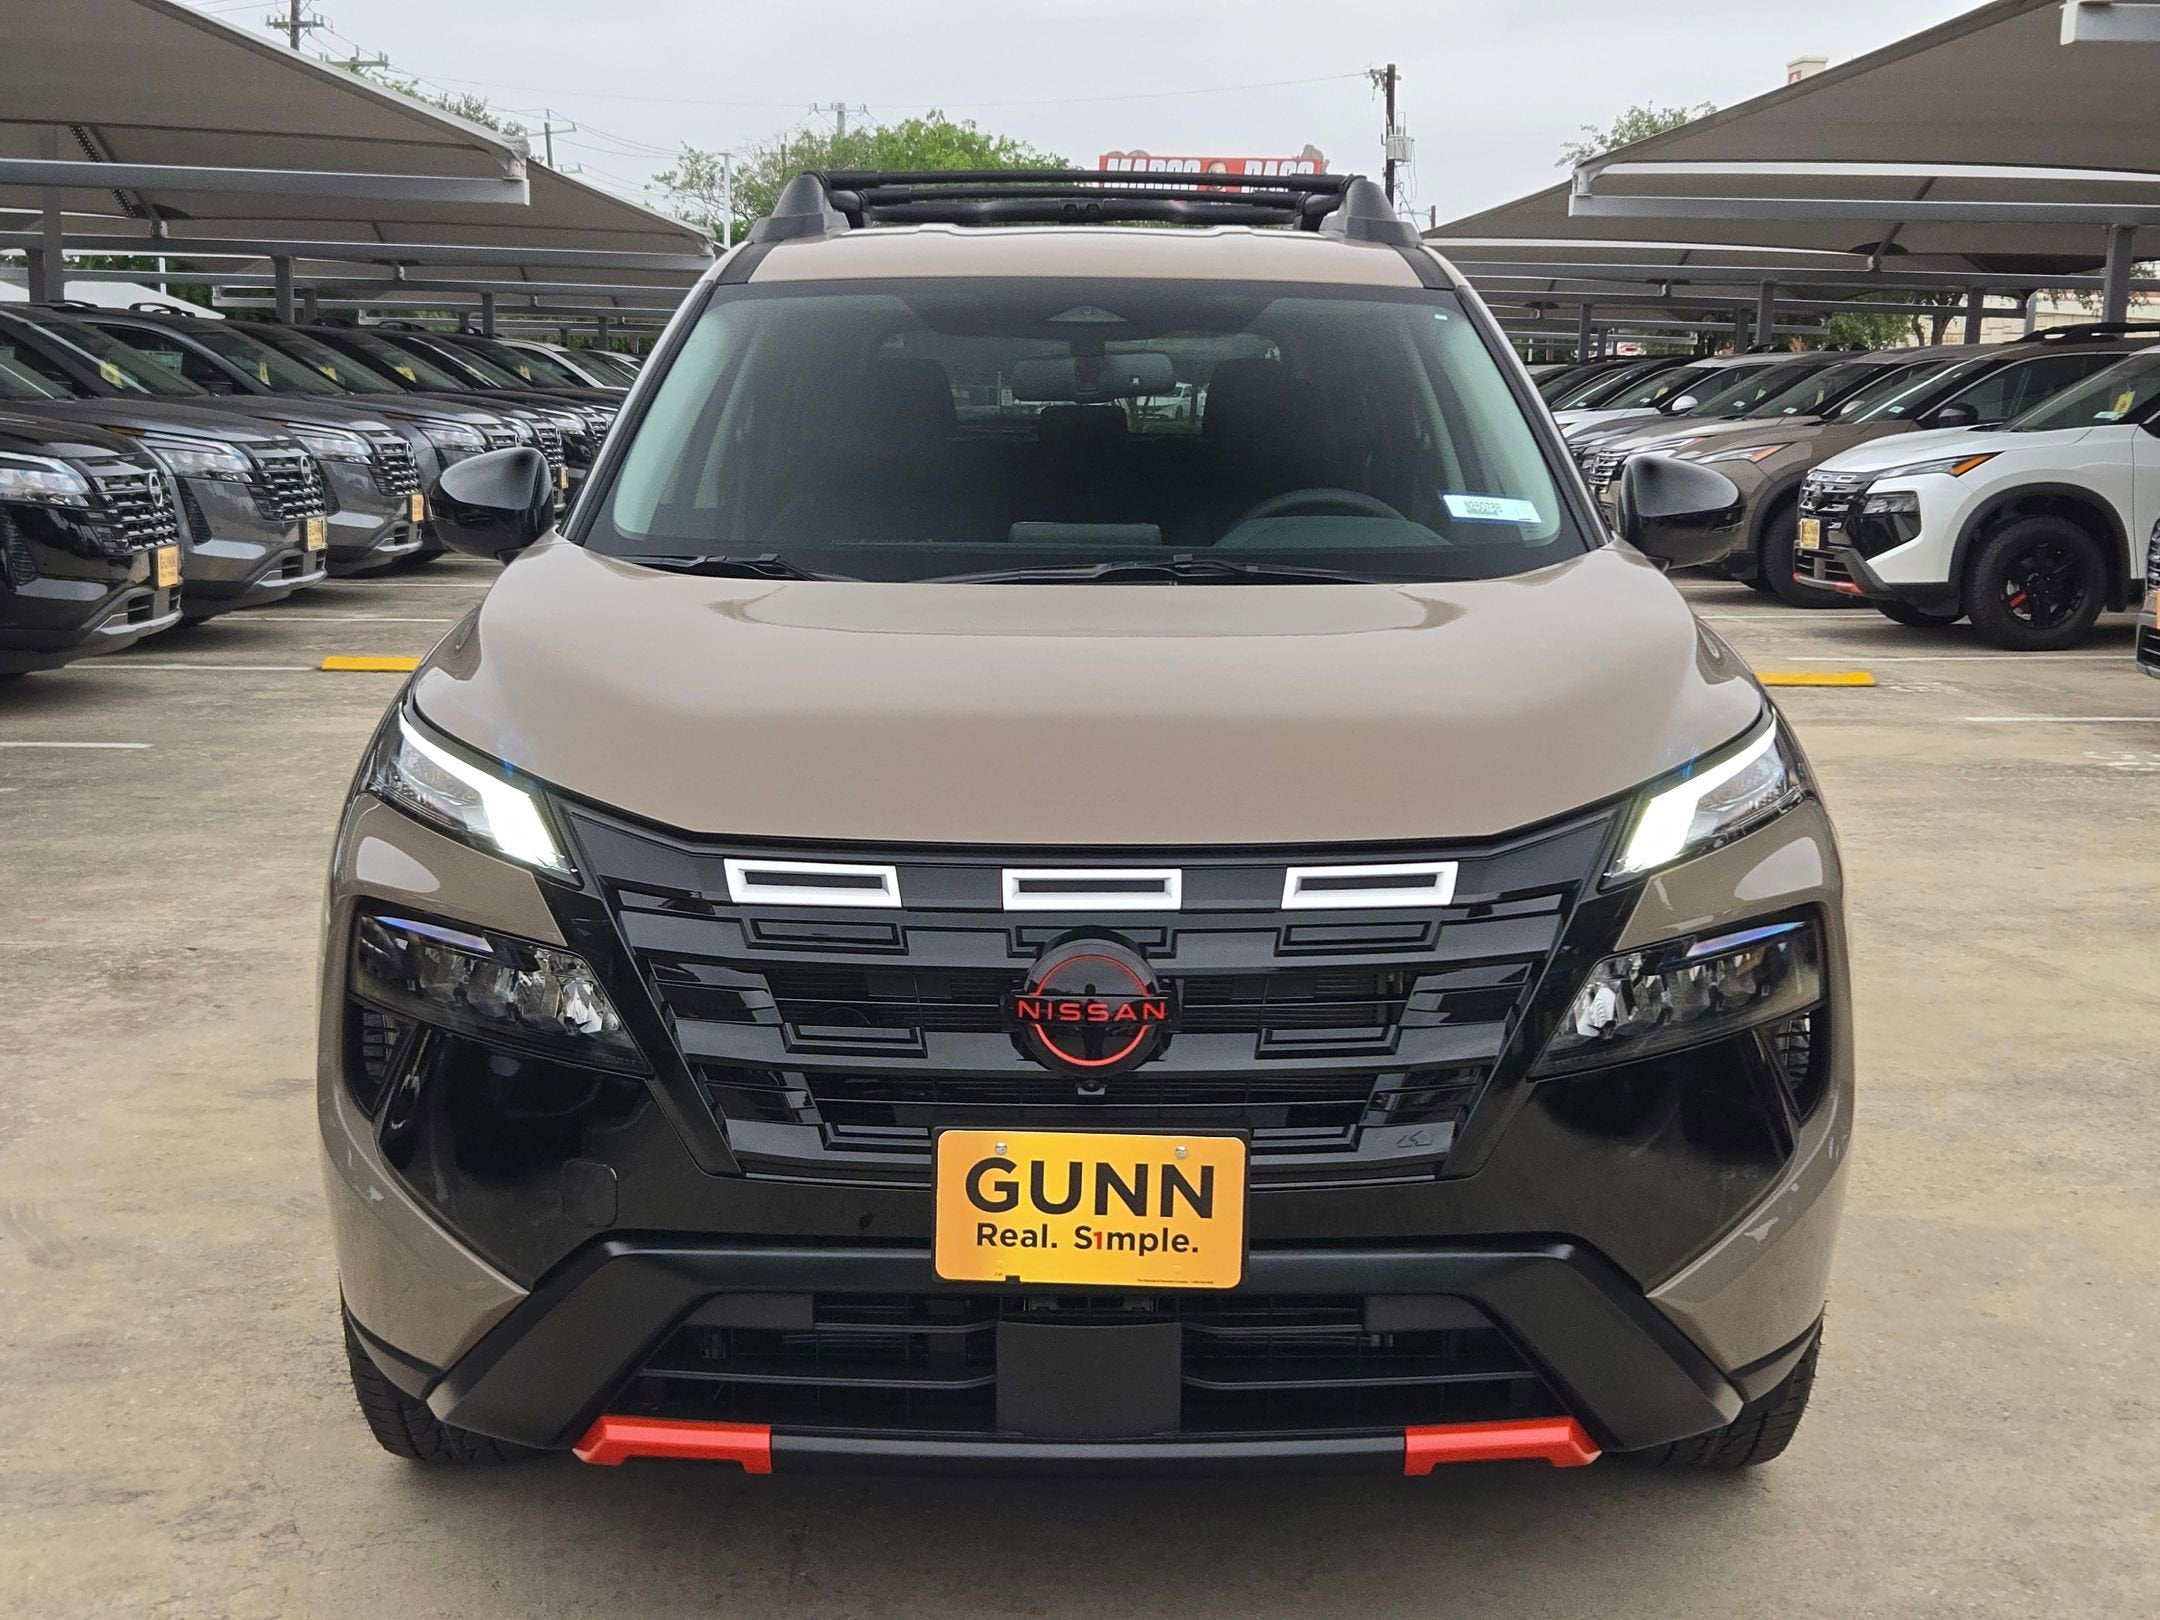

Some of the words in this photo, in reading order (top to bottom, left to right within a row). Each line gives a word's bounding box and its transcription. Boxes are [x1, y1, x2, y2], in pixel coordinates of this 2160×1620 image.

[1017, 1000, 1166, 1022] NISSAN
[965, 1157, 1215, 1219] GUNN
[976, 1222, 1058, 1249] Real.
[1073, 1225, 1199, 1256] S1mple.
